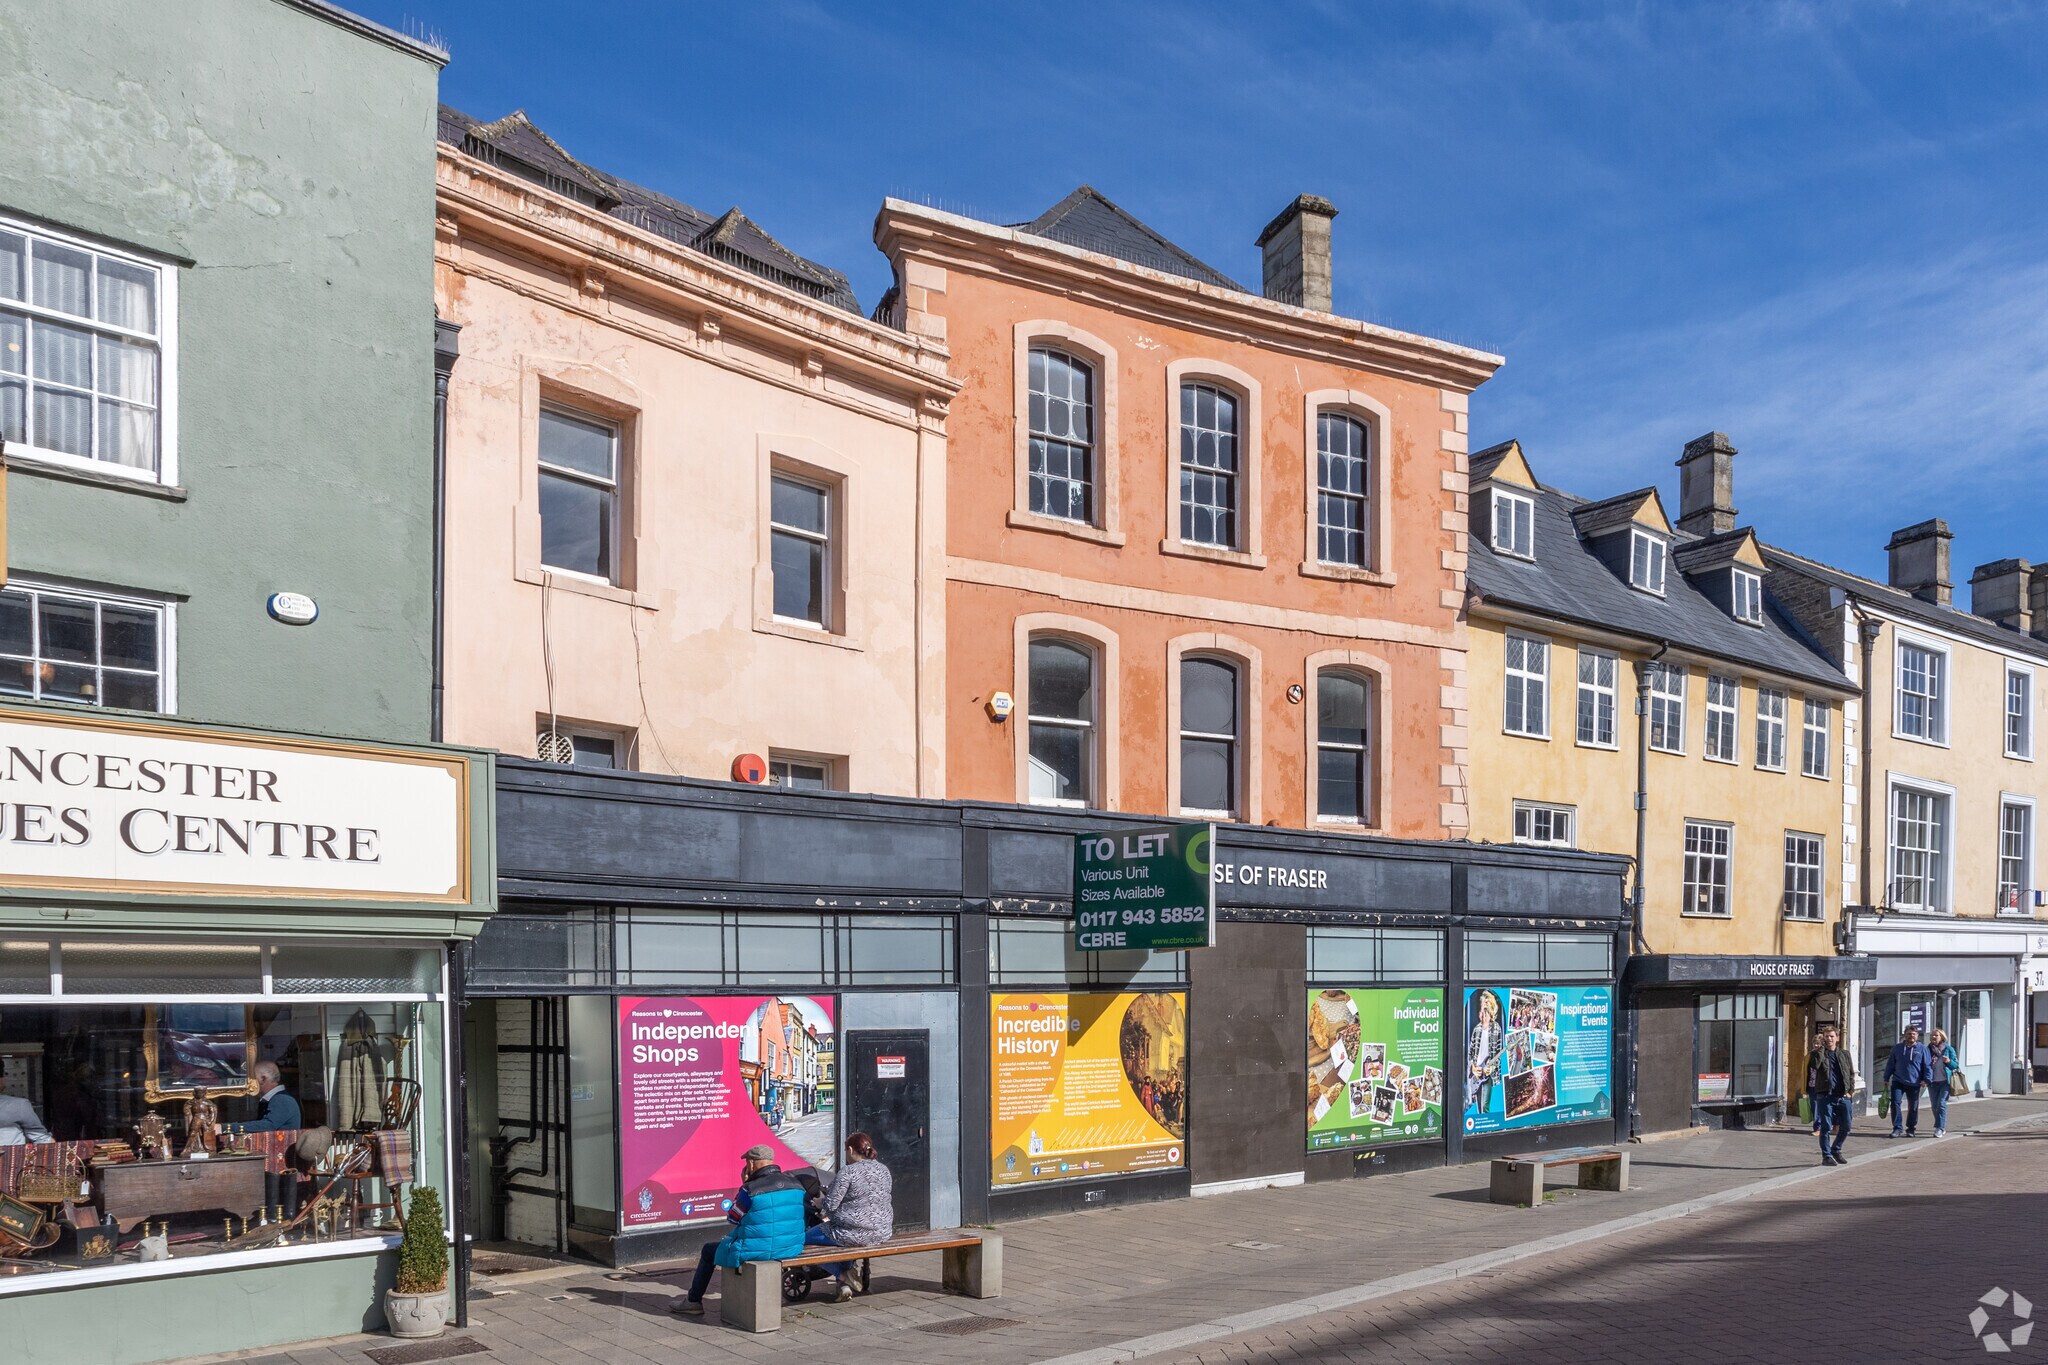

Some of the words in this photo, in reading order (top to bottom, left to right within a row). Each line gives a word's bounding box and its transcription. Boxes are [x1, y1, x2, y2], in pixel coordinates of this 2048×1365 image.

[0, 746, 281, 803] NCESTER
[120, 808, 381, 863] CENTRE
[1081, 838, 1115, 861] TO
[1123, 833, 1170, 859] LET
[1081, 868, 1122, 882] Various
[1126, 866, 1149, 879] Unit
[1239, 865, 1263, 885] OF
[1268, 867, 1327, 889] FRASER
[1081, 889, 1111, 902] Sizes
[1113, 885, 1165, 900] Available
[1080, 911, 1117, 927] 0117
[1122, 909, 1155, 925] 943
[1161, 906, 1205, 923] 5852
[1080, 932, 1127, 947] CBRE
[1152, 936, 1204, 945] www.cbre.co.uk
[1750, 963, 1776, 976] HOUSE
[1777, 963, 1788, 976] OF
[1789, 964, 1815, 976] FRASER
[1394, 1006, 1439, 1019] Individual
[1560, 1002, 1608, 1017] Inspirational
[998, 1015, 1080, 1033] Incredible
[1413, 1020, 1439, 1033] Food
[1581, 1015, 1608, 1026] Events
[998, 1036, 1059, 1057] History
[632, 1044, 699, 1067] Shops
